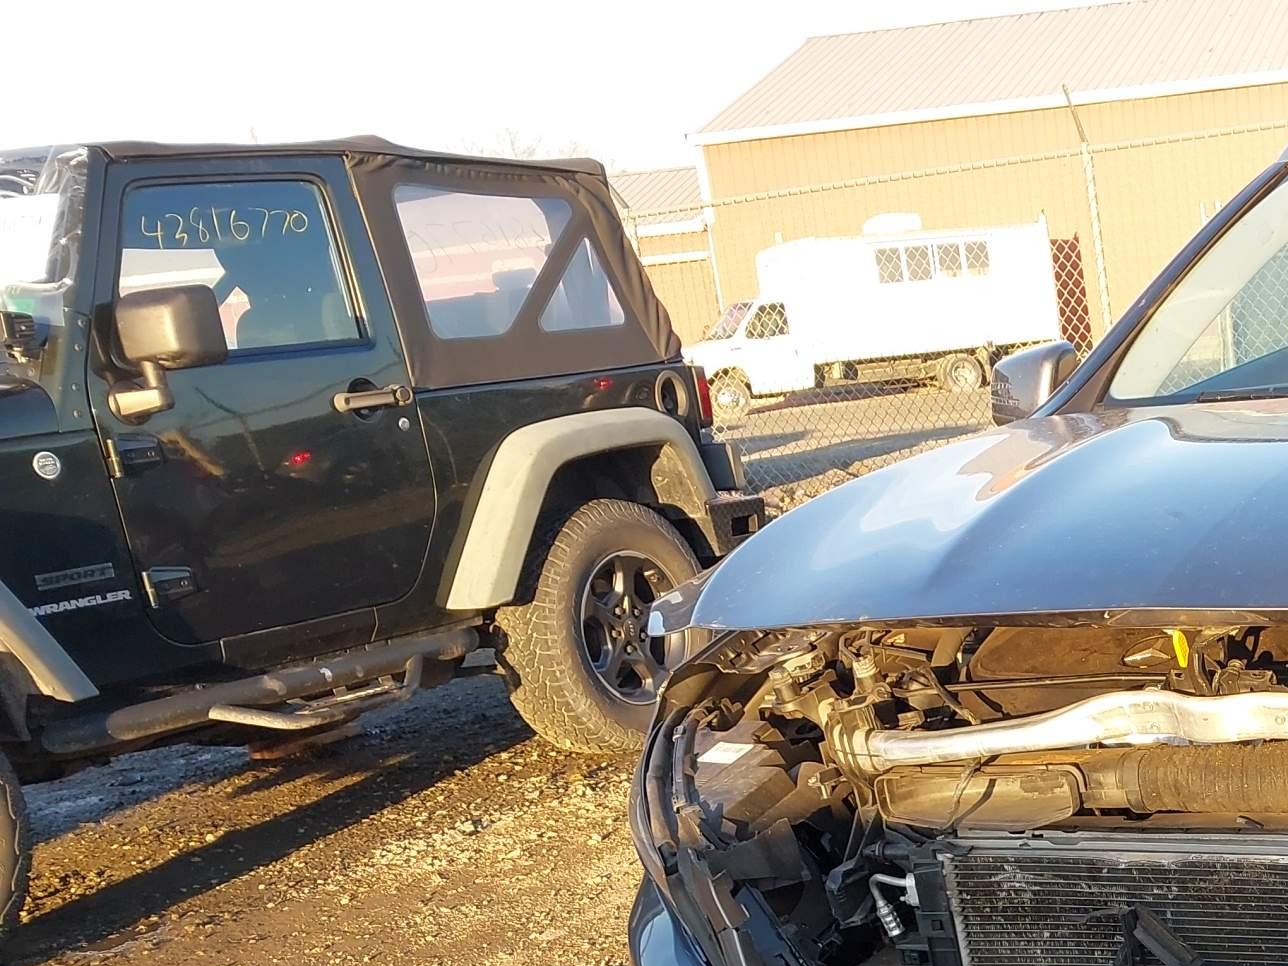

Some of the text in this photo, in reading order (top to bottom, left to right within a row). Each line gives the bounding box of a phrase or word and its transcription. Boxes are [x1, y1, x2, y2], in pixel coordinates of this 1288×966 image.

[141, 206, 308, 250] 43816770
[38, 565, 112, 587] SPORT
[28, 590, 133, 617] WRANGLER
